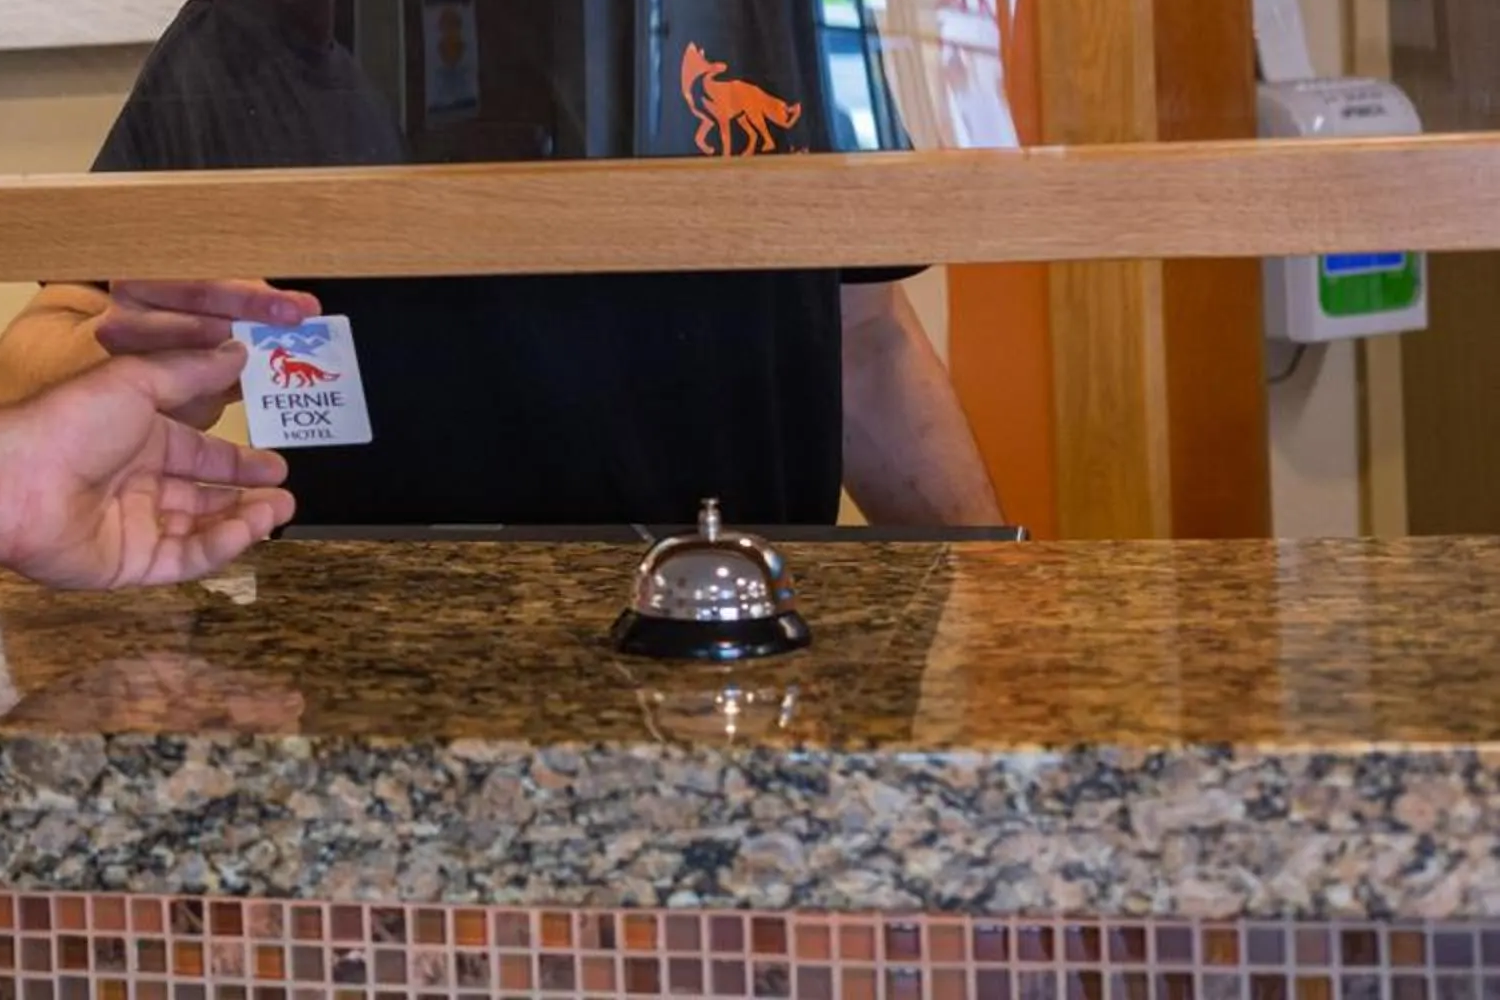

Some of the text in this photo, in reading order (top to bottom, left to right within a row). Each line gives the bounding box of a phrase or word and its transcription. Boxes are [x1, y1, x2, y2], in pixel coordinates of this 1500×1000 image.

[261, 391, 345, 409] FERNIE
[281, 410, 332, 427] FOX
[283, 428, 336, 441] HOTEL
